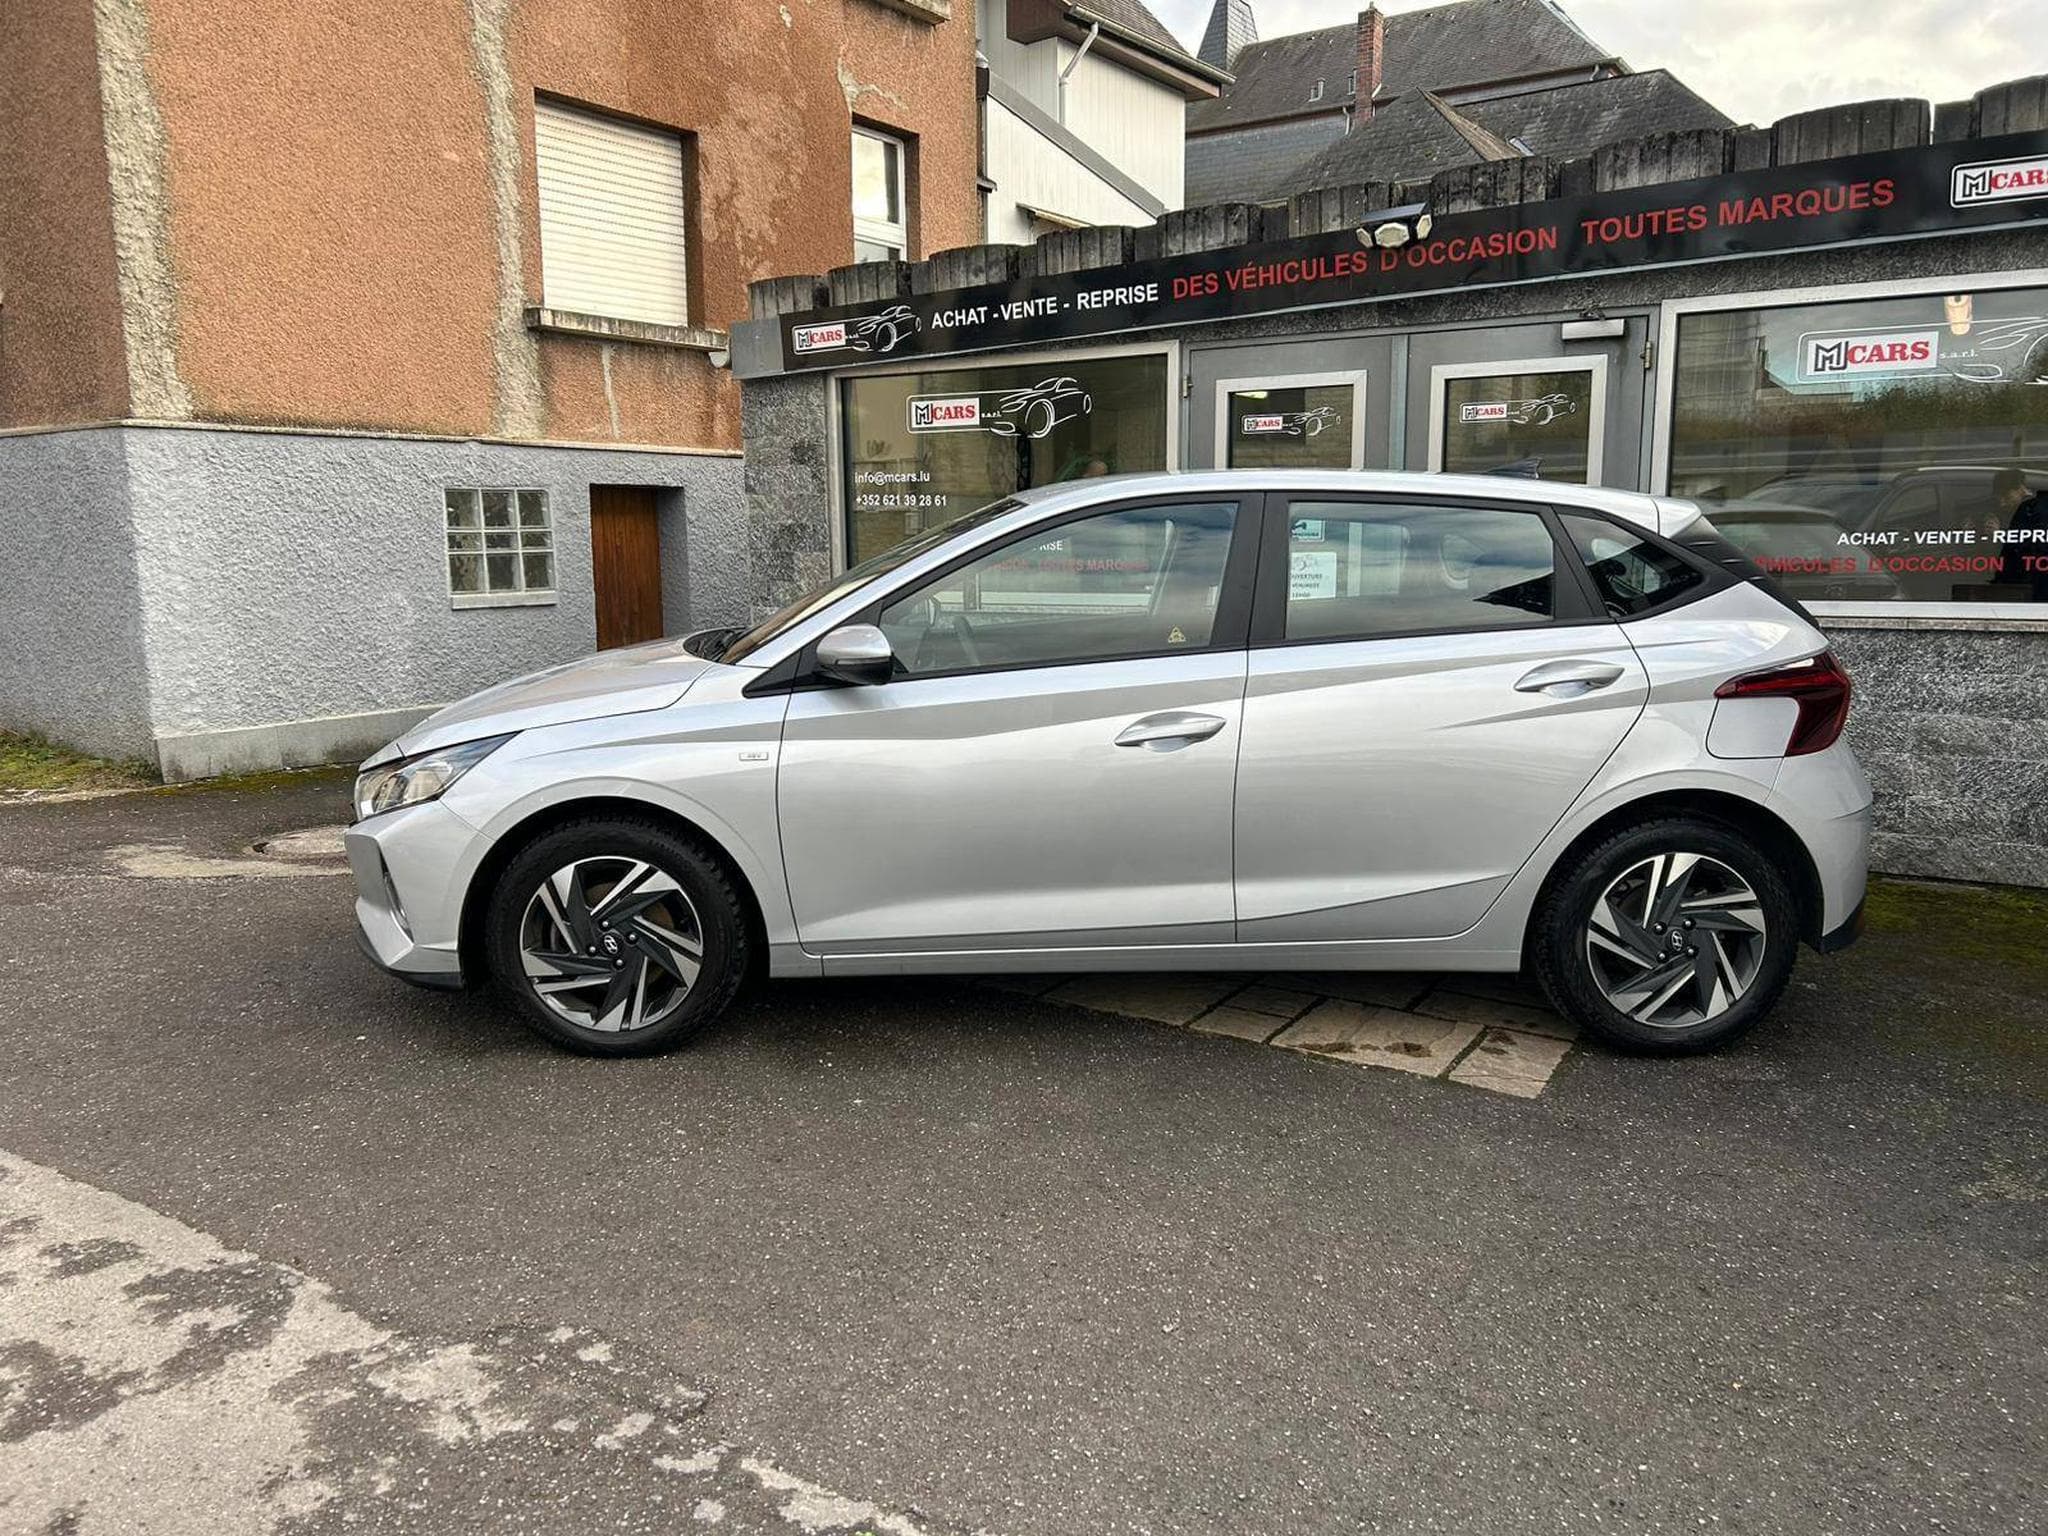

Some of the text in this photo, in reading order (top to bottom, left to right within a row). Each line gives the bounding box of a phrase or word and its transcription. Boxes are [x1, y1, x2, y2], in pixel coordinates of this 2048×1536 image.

[931, 306, 988, 330] ACHAT
[1077, 284, 1159, 311] REPRISE
[1173, 272, 1219, 300] DES
[1225, 251, 1368, 291] VÉHICULES
[1381, 226, 1557, 273] D'OCCASION
[1581, 204, 1708, 245] TOUTES
[1717, 179, 1896, 226] MARQUES
[855, 471, 931, 486] info@mcars.lu
[856, 494, 947, 507] +352 621 39 28 61
[1836, 531, 1899, 545] ACHAT
[1914, 530, 1976, 544] VENTE
[1868, 556, 2004, 573] D'OCCASION
